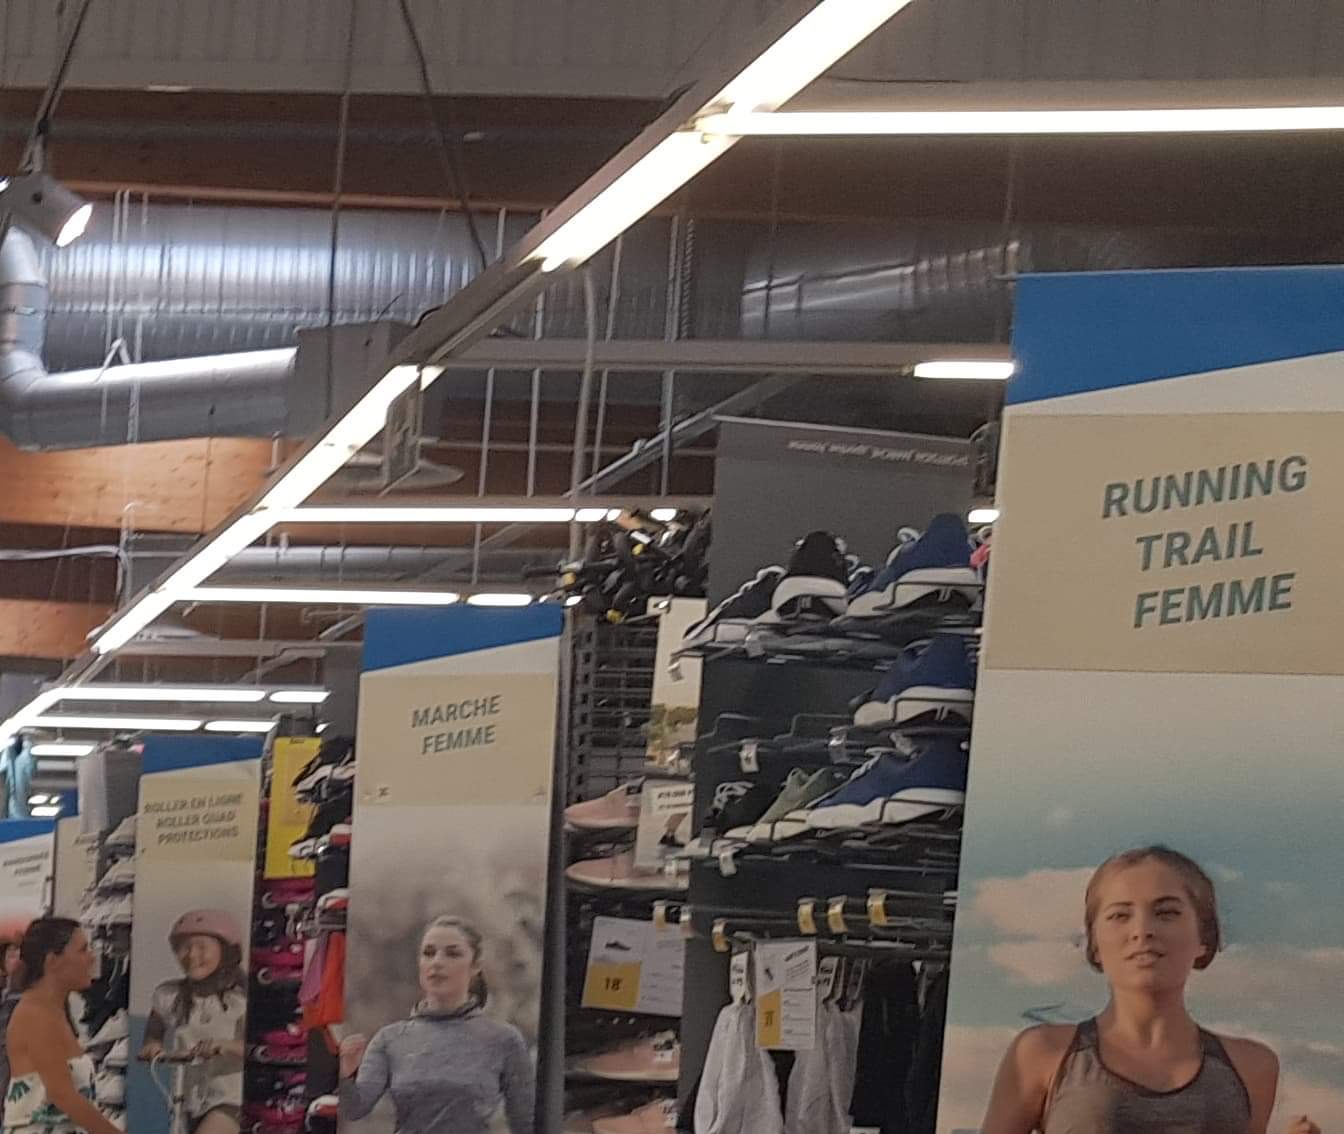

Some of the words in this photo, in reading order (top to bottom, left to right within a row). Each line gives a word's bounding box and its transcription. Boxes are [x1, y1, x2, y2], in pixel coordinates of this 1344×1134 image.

[1102, 455, 1308, 519] RUNNING
[1135, 520, 1264, 572] TRAIL
[1133, 573, 1296, 629] FEMME
[411, 694, 503, 728] MARCHE
[421, 724, 496, 755] FEMME
[144, 799, 188, 814] ROLLER
[156, 814, 200, 829] ROLLER
